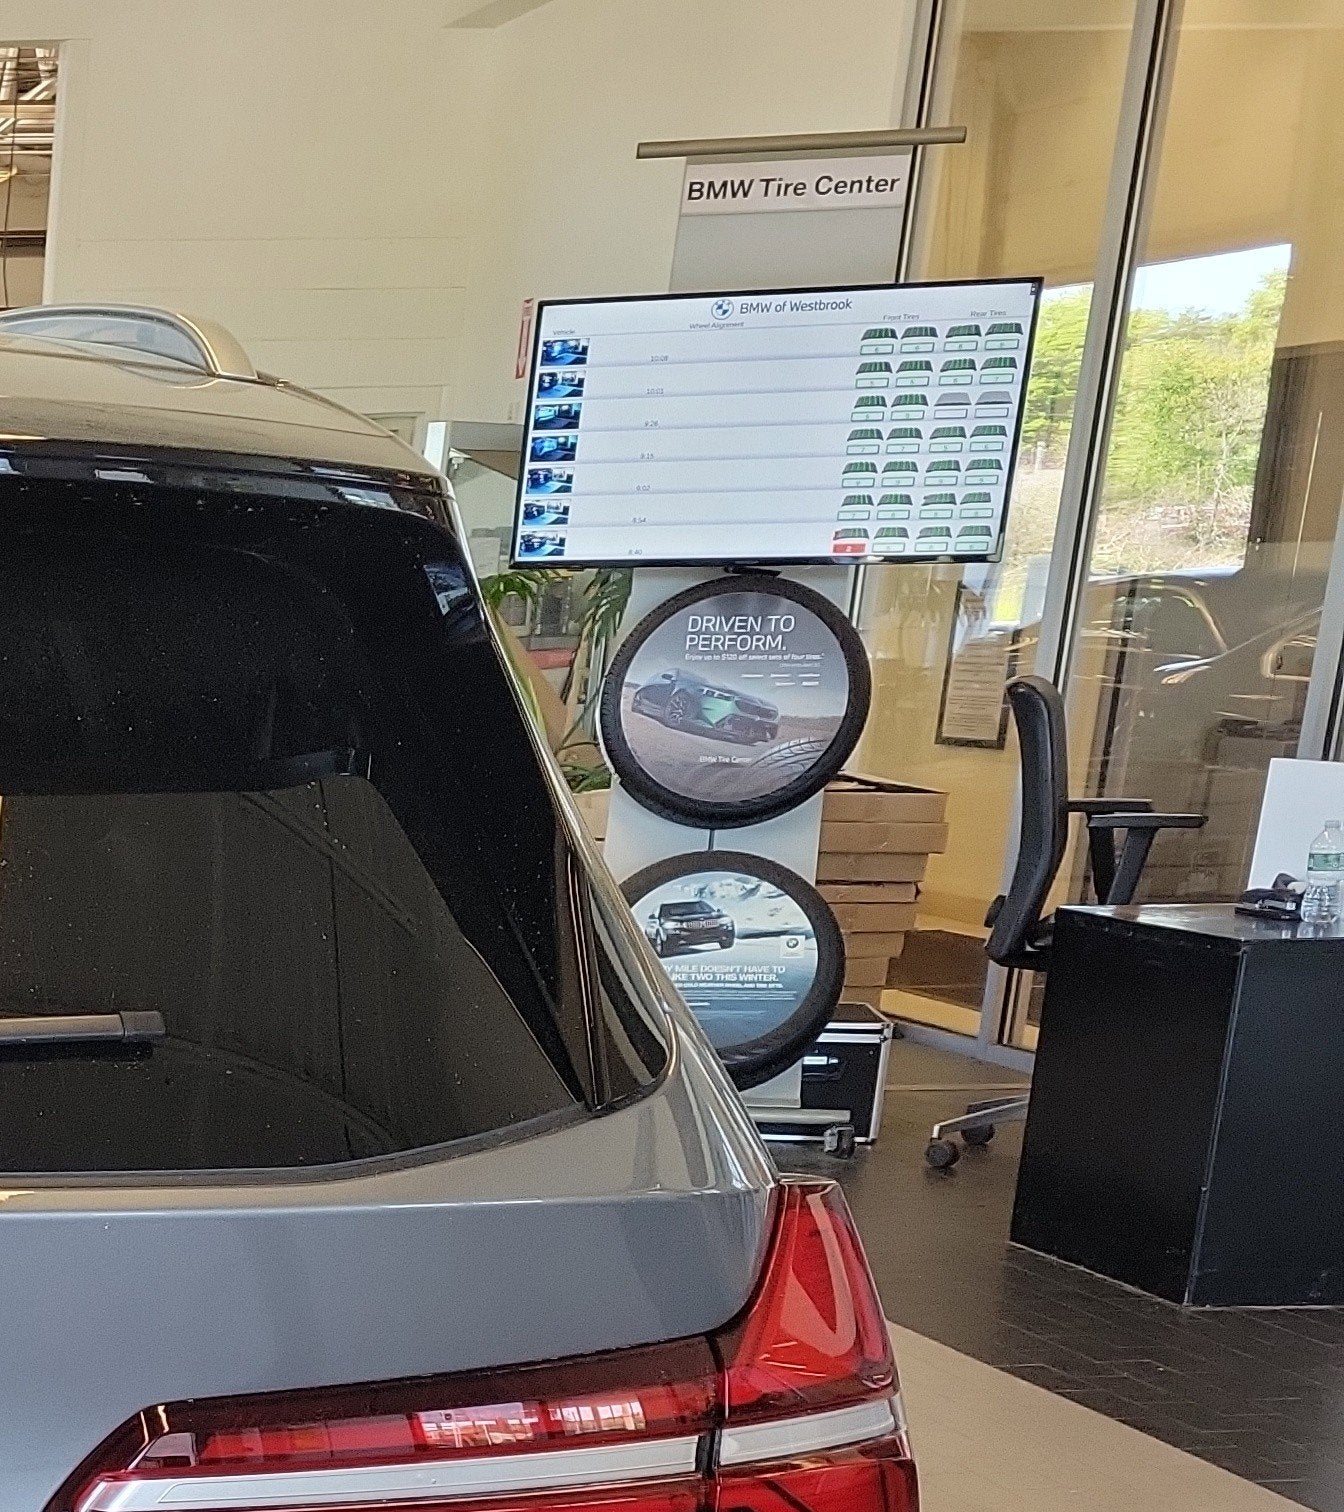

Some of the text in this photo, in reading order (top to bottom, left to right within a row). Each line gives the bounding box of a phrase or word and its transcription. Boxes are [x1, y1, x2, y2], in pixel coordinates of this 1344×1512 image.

[687, 173, 901, 202] BMW Tire Center
[739, 297, 853, 315] BMW of Westbrook
[689, 320, 744, 330] Wheel Alignment
[553, 328, 576, 336] Vehicle
[687, 615, 795, 632] DRIVEN TO
[685, 634, 787, 652] PERFORM.
[685, 653, 703, 661] Enjoy
[675, 965, 698, 973] MILE
[700, 965, 741, 973] DOESN'T
[743, 965, 770, 973] HAVE
[772, 965, 786, 973] TO
[690, 973, 714, 981] TWO
[715, 973, 737, 981] THIS
[739, 973, 779, 981] WINTER.
